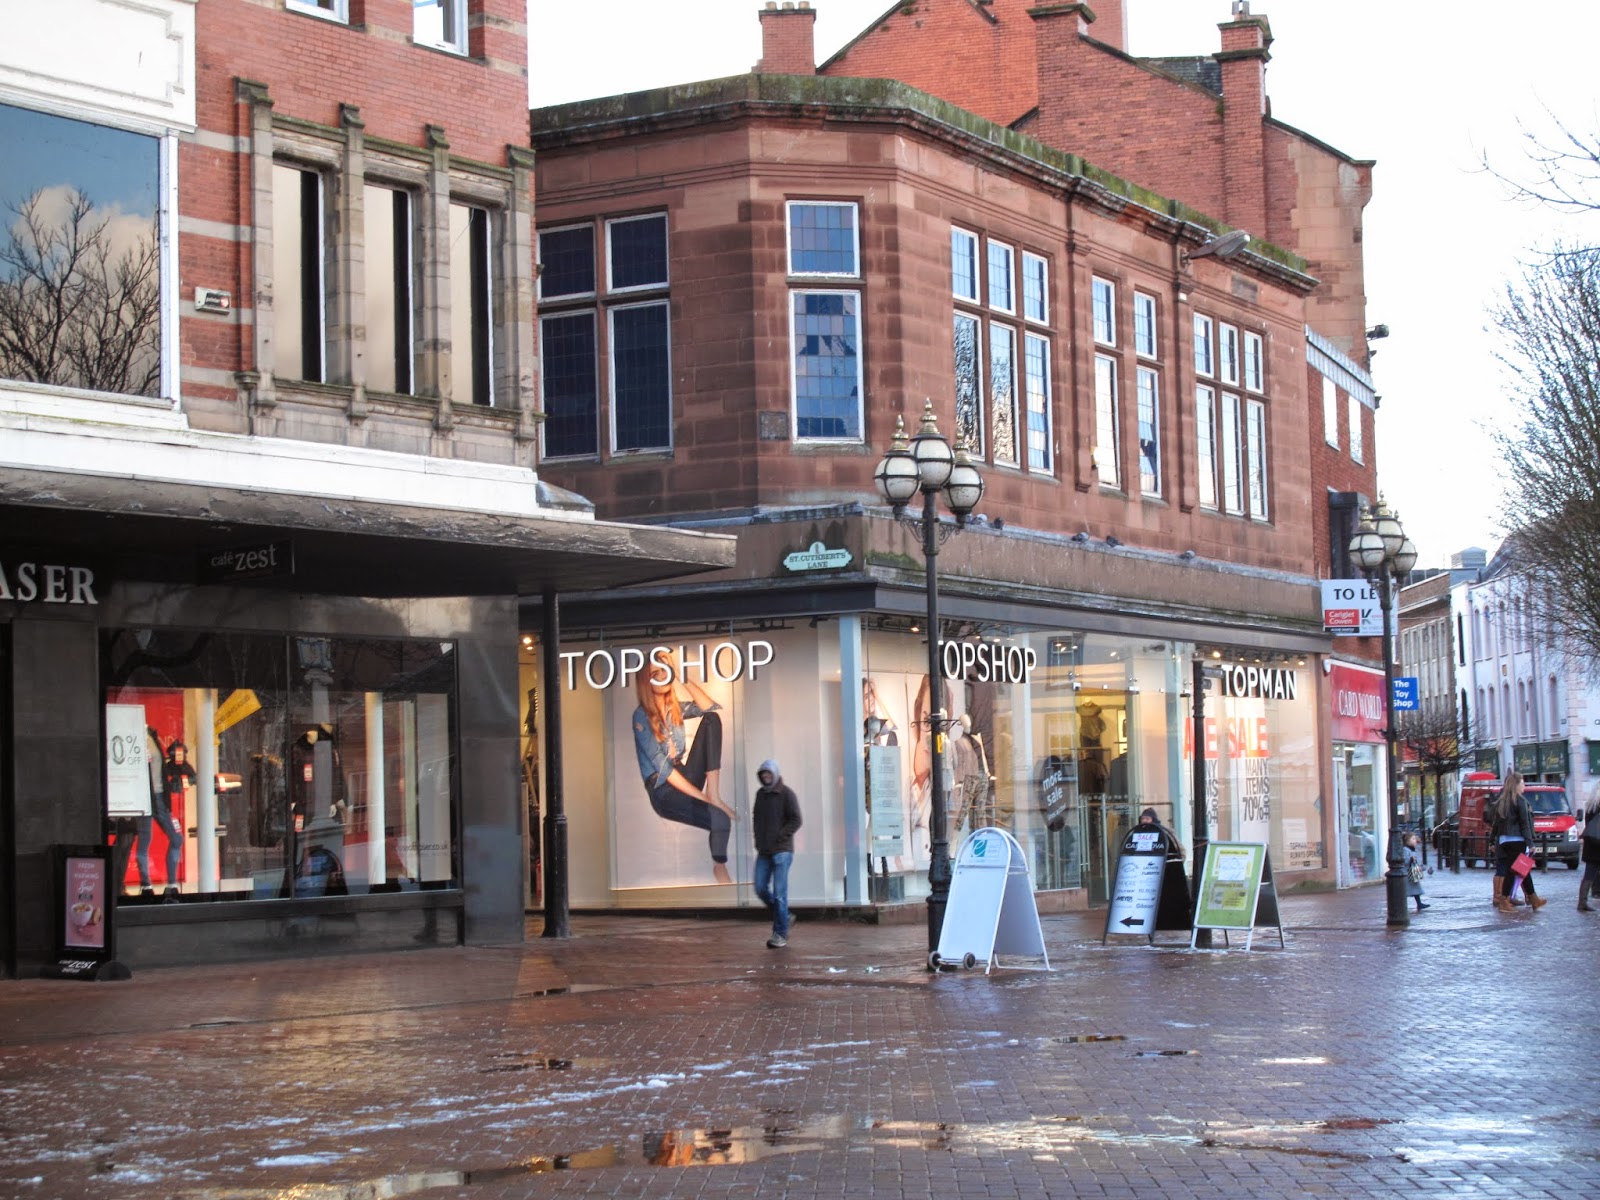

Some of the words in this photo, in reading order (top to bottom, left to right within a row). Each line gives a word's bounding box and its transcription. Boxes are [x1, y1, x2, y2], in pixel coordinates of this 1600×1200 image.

[211, 551, 233, 567] café
[235, 543, 277, 571] zest
[808, 561, 828, 569] LANE
[1333, 588, 1355, 601] TO
[1360, 588, 1378, 600] LE
[1328, 617, 1353, 625] Cowen
[559, 640, 774, 691] TOPSHOP
[1221, 664, 1298, 701] TOPMAN
[1394, 680, 1410, 688] The
[1338, 689, 1359, 717] CARD
[1357, 692, 1382, 720] WORLD
[1394, 699, 1414, 709] Shop
[1395, 690, 1410, 700] Toy
[1228, 717, 1271, 758] SALE
[127, 756, 142, 766] OFF
[1245, 758, 1269, 778] MANY
[1042, 769, 1063, 792] more
[1245, 776, 1270, 796] ITEMS
[1046, 785, 1064, 807] sale
[1242, 796, 1264, 822] 70%
[1125, 842, 1165, 850] CAOVA
[1137, 833, 1154, 841] SALE
